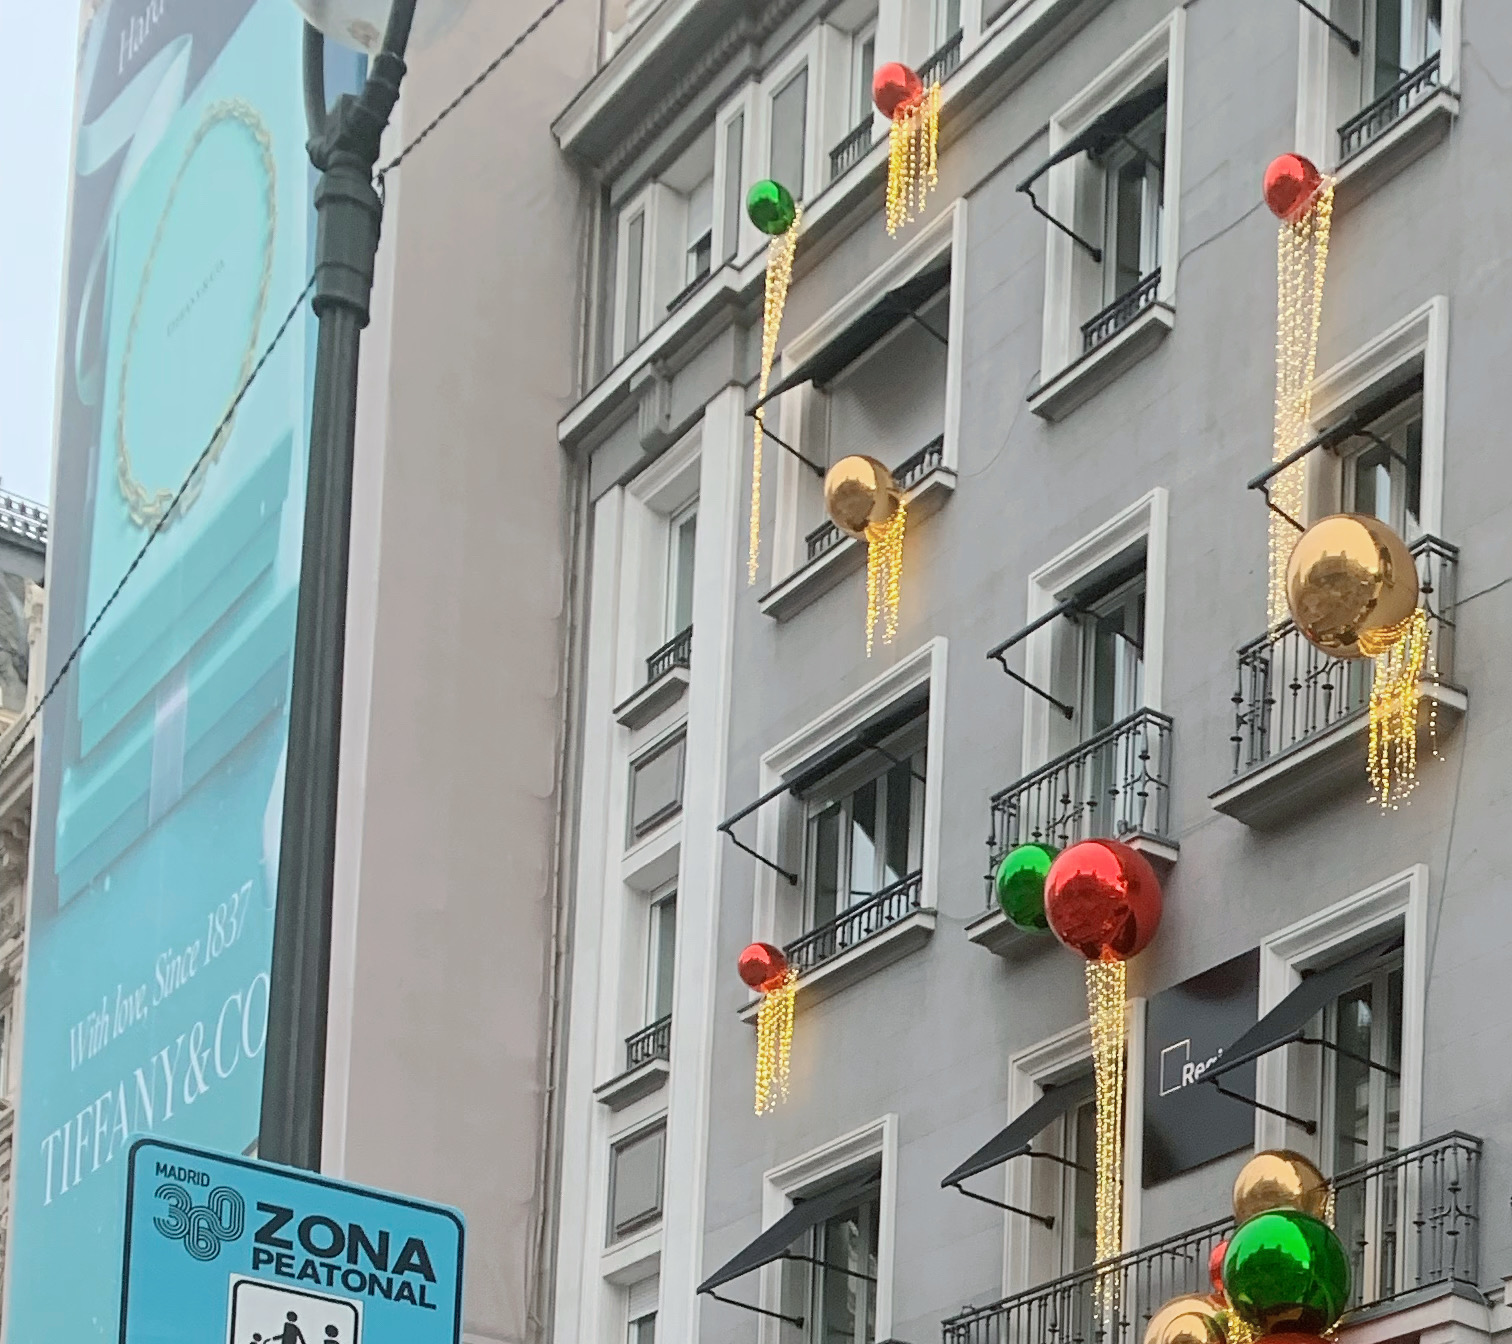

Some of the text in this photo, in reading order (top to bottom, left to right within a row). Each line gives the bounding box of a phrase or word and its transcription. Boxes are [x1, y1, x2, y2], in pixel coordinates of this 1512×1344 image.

[70, 879, 254, 1072] With love, Since 1837
[155, 1161, 211, 1187] MADRID
[153, 1183, 245, 1262] 360
[254, 1201, 437, 1284] ZONA
[251, 1246, 438, 1311] PEATONAL
